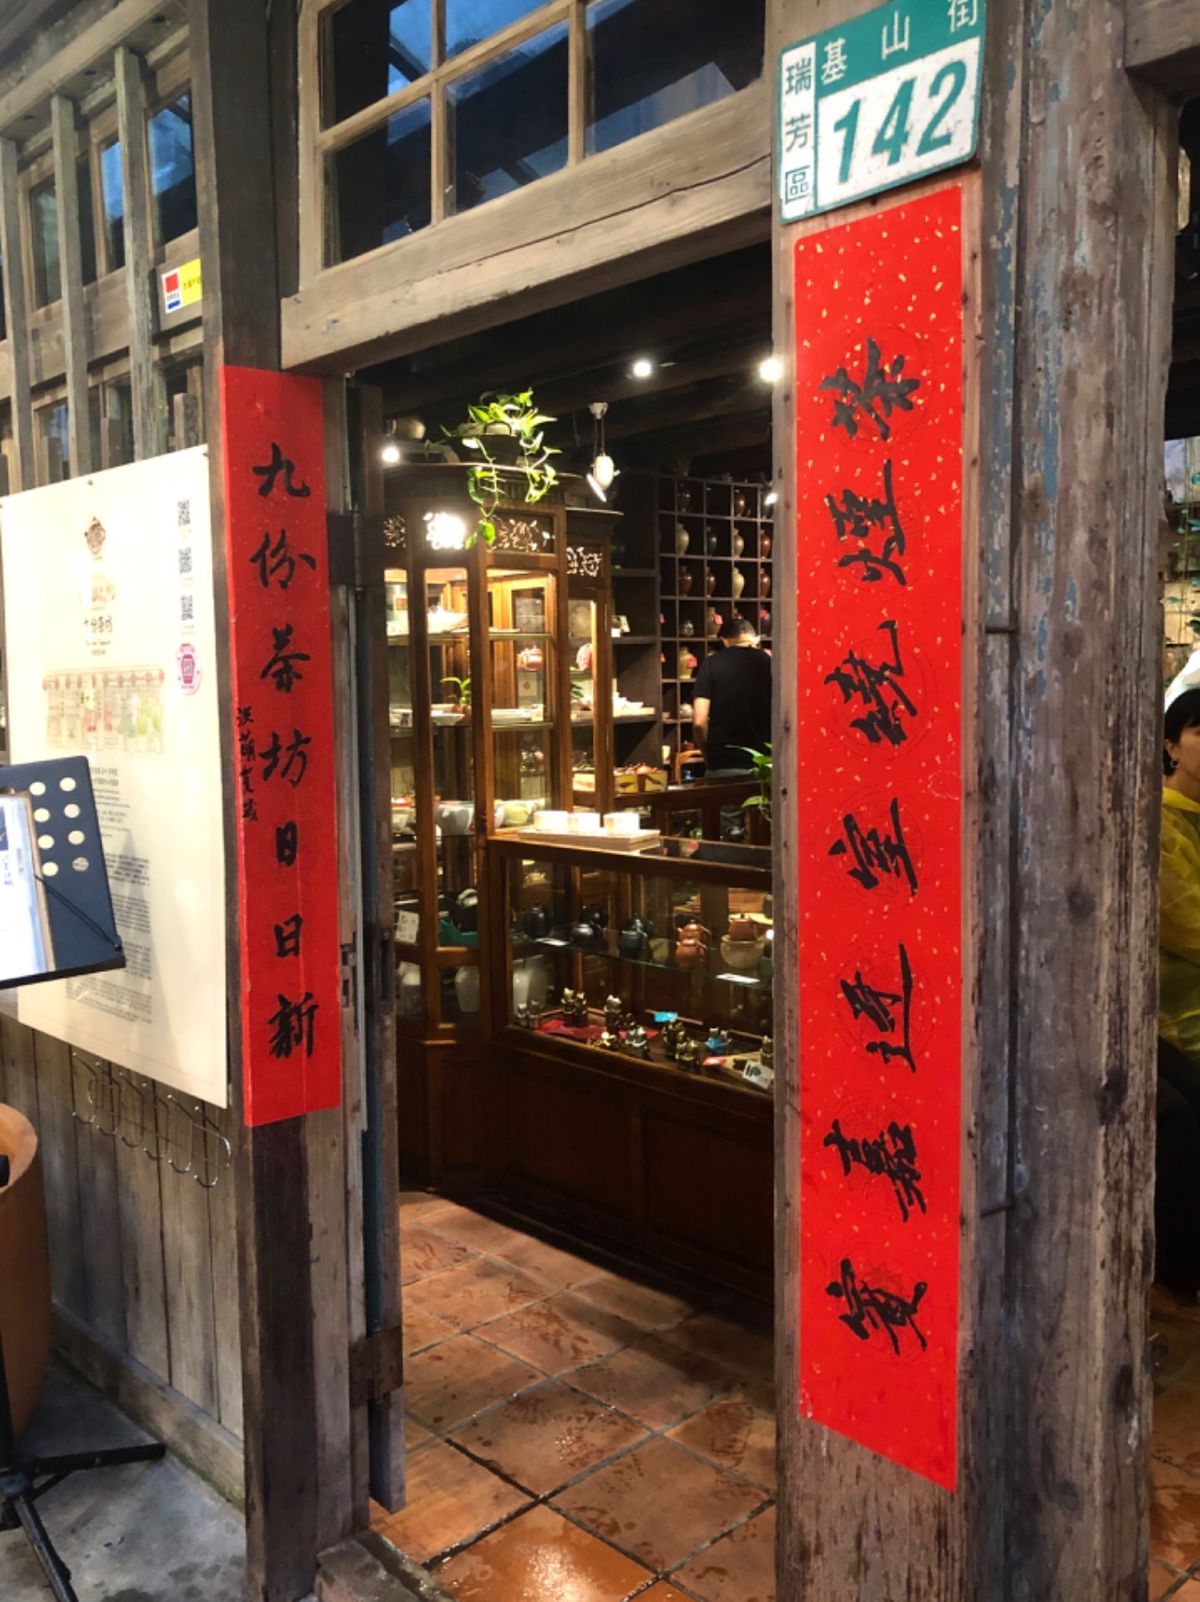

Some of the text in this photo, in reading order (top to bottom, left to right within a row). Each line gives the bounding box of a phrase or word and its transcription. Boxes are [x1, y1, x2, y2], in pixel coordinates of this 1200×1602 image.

[820, 0, 977, 85] 基山街
[785, 57, 812, 203] 瑞芳區
[833, 60, 967, 184] 142
[249, 442, 319, 1060] 九份茶坊日日新
